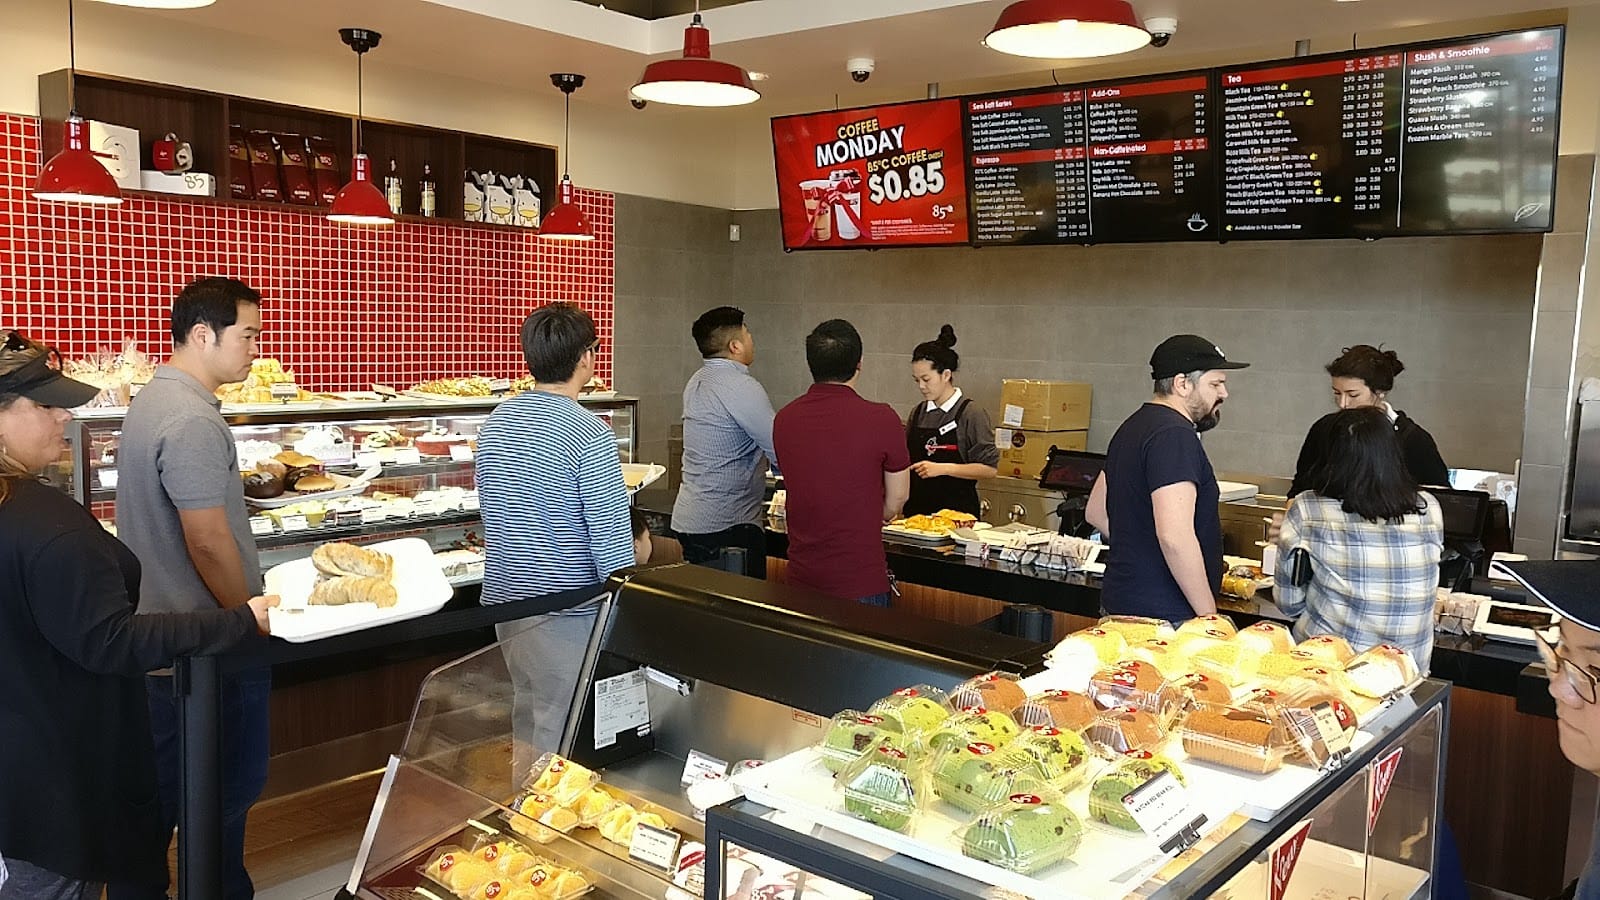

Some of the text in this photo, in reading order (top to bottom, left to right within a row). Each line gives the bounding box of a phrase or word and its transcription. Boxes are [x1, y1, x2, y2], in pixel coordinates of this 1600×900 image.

[1414, 53, 1437, 62] Slush
[1447, 46, 1490, 58] Smoothie
[1433, 65, 1451, 73] Slush
[1459, 72, 1477, 80] Slush
[1453, 82, 1486, 90] Smoothie
[1409, 96, 1445, 104] Strawberry
[1408, 106, 1444, 114] Strawberry
[1430, 114, 1448, 122] Slush
[838, 119, 879, 139] COFFEE
[1408, 125, 1433, 133] Cookies
[816, 126, 904, 167] MONDAY
[891, 150, 927, 167] COFFEE
[185, 175, 204, 189] 85
[869, 161, 944, 204] $0.85
